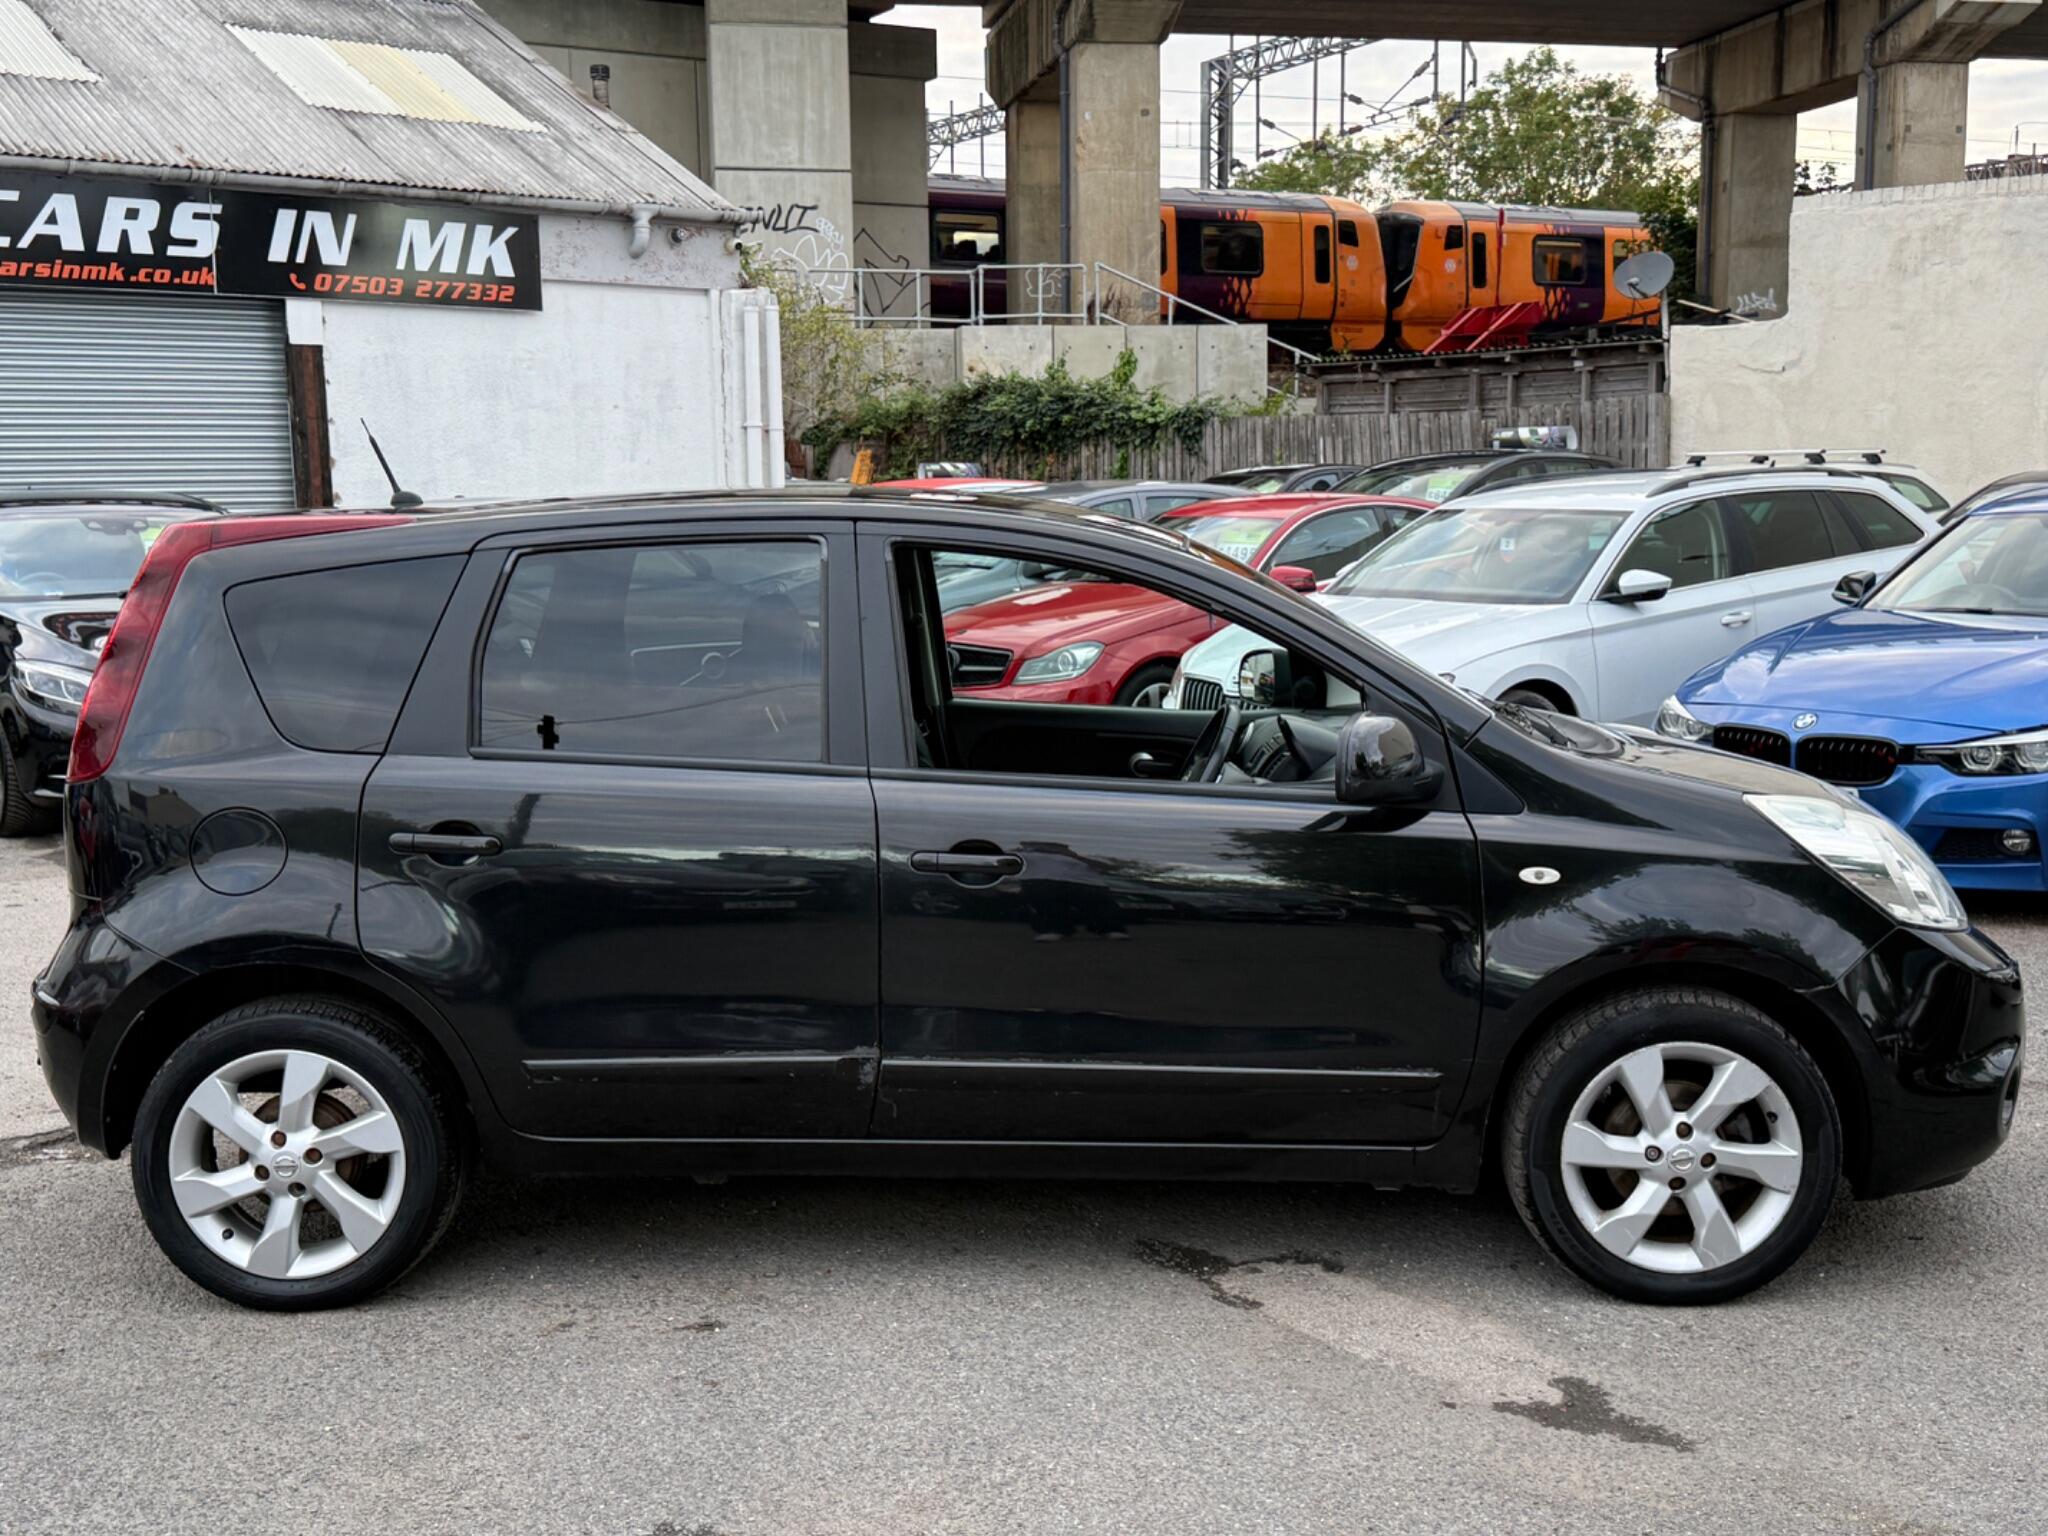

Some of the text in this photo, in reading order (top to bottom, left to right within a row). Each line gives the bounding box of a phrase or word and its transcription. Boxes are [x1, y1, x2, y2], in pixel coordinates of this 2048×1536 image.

[268, 208, 357, 266] IN
[396, 218, 519, 278] MK
[313, 272, 516, 303] 07503 277332
